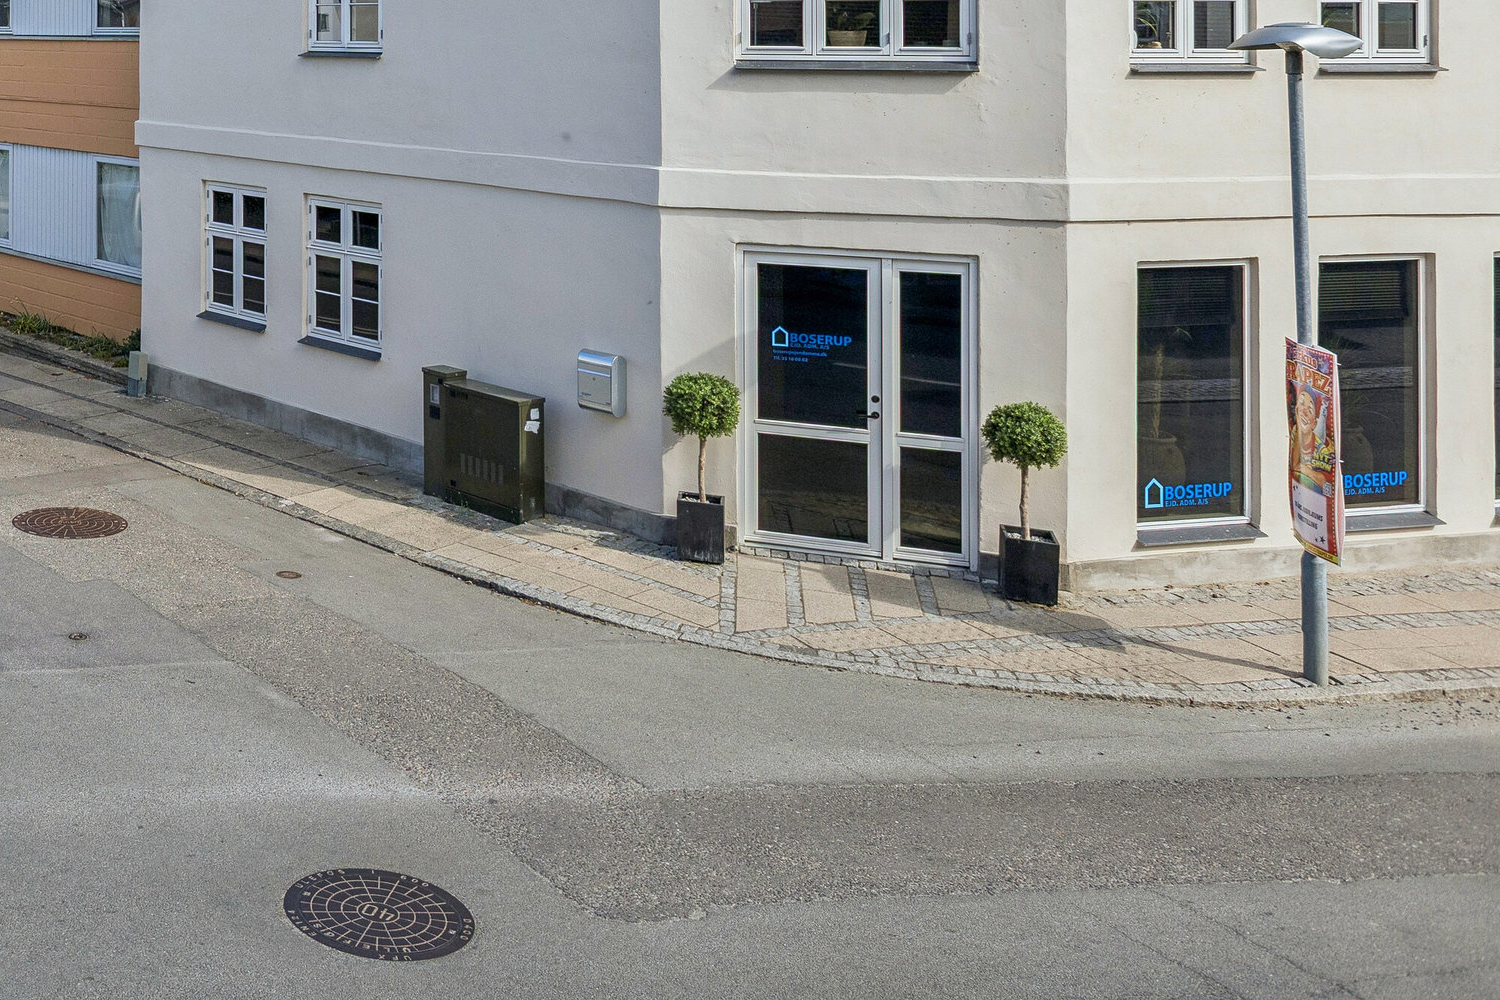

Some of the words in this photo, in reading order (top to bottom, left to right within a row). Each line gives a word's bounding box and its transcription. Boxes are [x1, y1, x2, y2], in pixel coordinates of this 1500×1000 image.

[790, 332, 852, 347] BOSERUP
[1286, 359, 1331, 398] RAPEZ
[1344, 471, 1408, 489] BOSERUP
[1164, 482, 1232, 500] BOSERUP
[362, 903, 396, 921] 40
